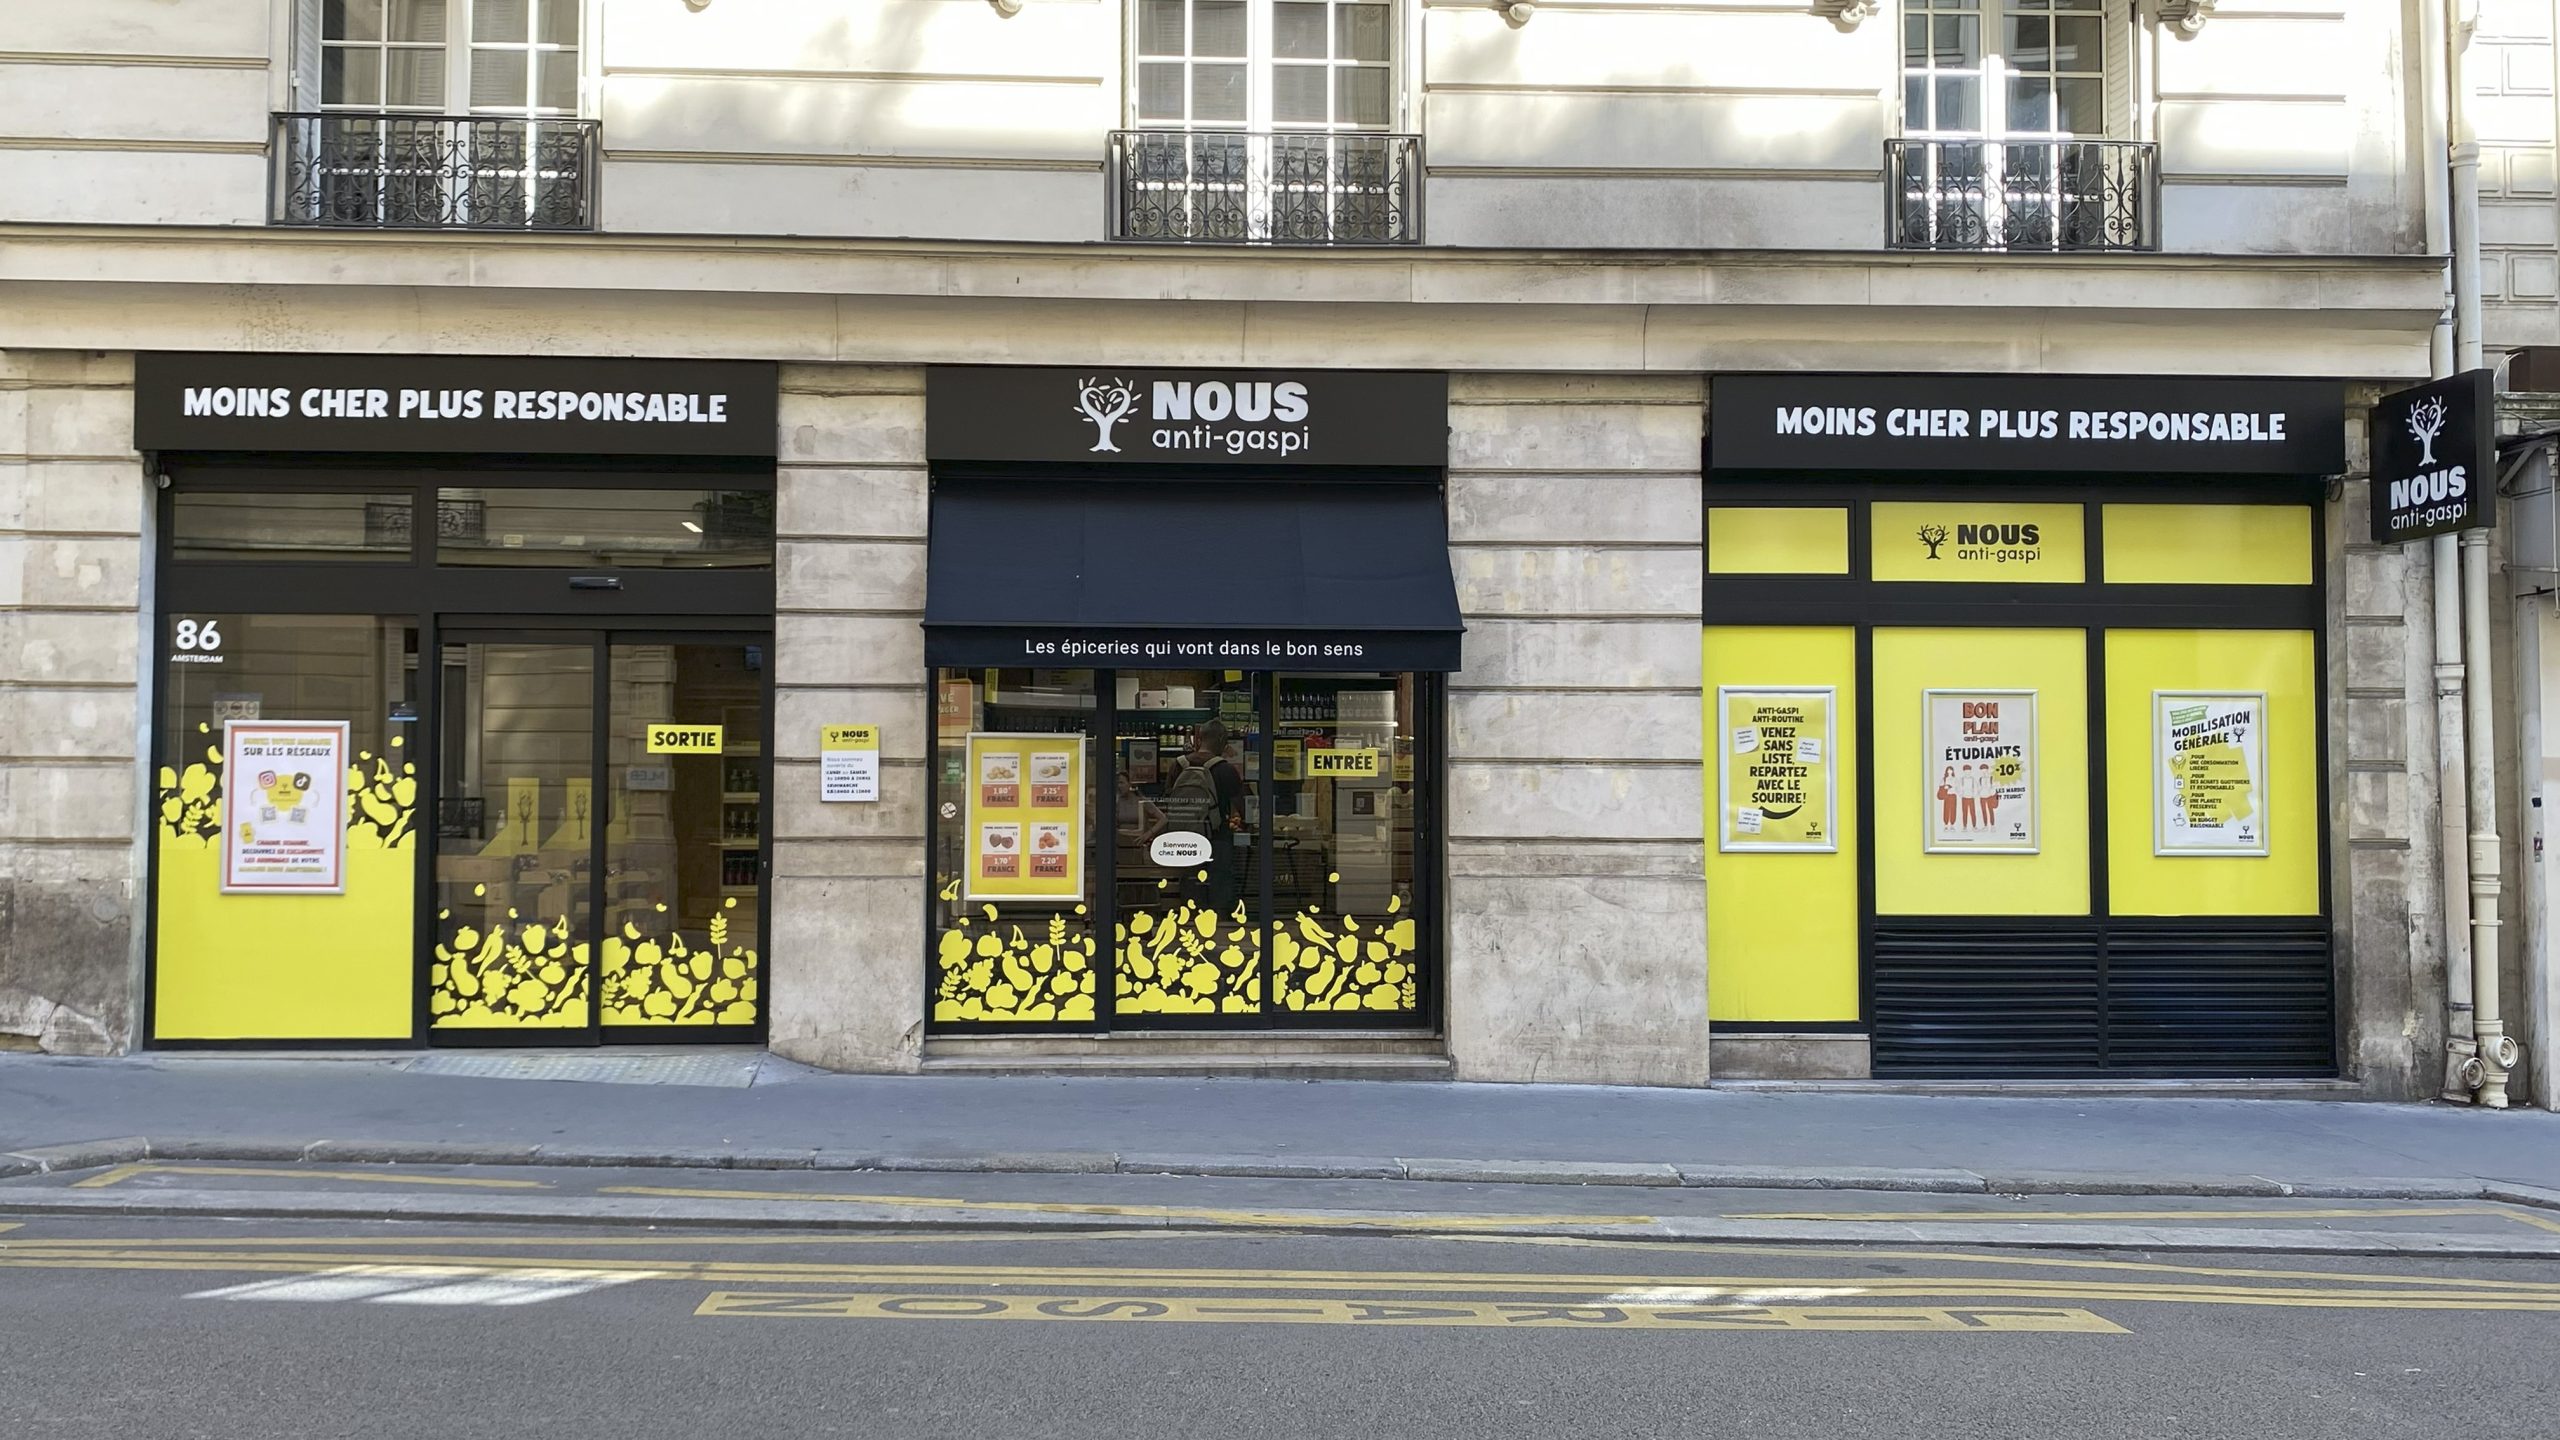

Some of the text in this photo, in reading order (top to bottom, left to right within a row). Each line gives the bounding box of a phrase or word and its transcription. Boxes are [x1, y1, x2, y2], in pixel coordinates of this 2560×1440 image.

[184, 387, 726, 422] MOINS CHER PLUS RESPONSABLE
[1153, 381, 1308, 422] NOUS
[1777, 407, 2285, 441] MOINS CHER PLUS RESPONSABLE
[1153, 425, 1308, 456] anti-gaspi
[2389, 465, 2469, 512] NOUS
[2390, 498, 2468, 530] anti-gaspi
[1958, 524, 2039, 550] NOUS
[1958, 547, 2040, 563] anti-gaspi
[176, 620, 220, 650] 86
[1026, 639, 1362, 658] Les épiceries qui vont dans le bon sens
[1757, 707, 1799, 715] ANTI-GASPI
[1963, 702, 1998, 718] BON
[1752, 715, 1804, 723] ANTI-ROUTINE
[2172, 711, 2250, 738] MOBILISATION
[1761, 727, 1796, 738] VENEZ
[1963, 722, 1998, 734] PLAN
[654, 731, 716, 747] SORTIE
[1764, 740, 1793, 751] SANS
[2174, 732, 2230, 751] GÉNÉRALE
[244, 748, 263, 756] SUR
[266, 748, 283, 756] LES
[1762, 753, 1795, 765] LISTE,
[1946, 746, 2021, 761] ÉTUDIANTS
[1313, 752, 1373, 770] ENTRÉE
[1750, 766, 1807, 777] REPARTEZ
[1757, 780, 1800, 790] AVEC LE
[717, 1295, 2068, 1327] LIVRAISON
